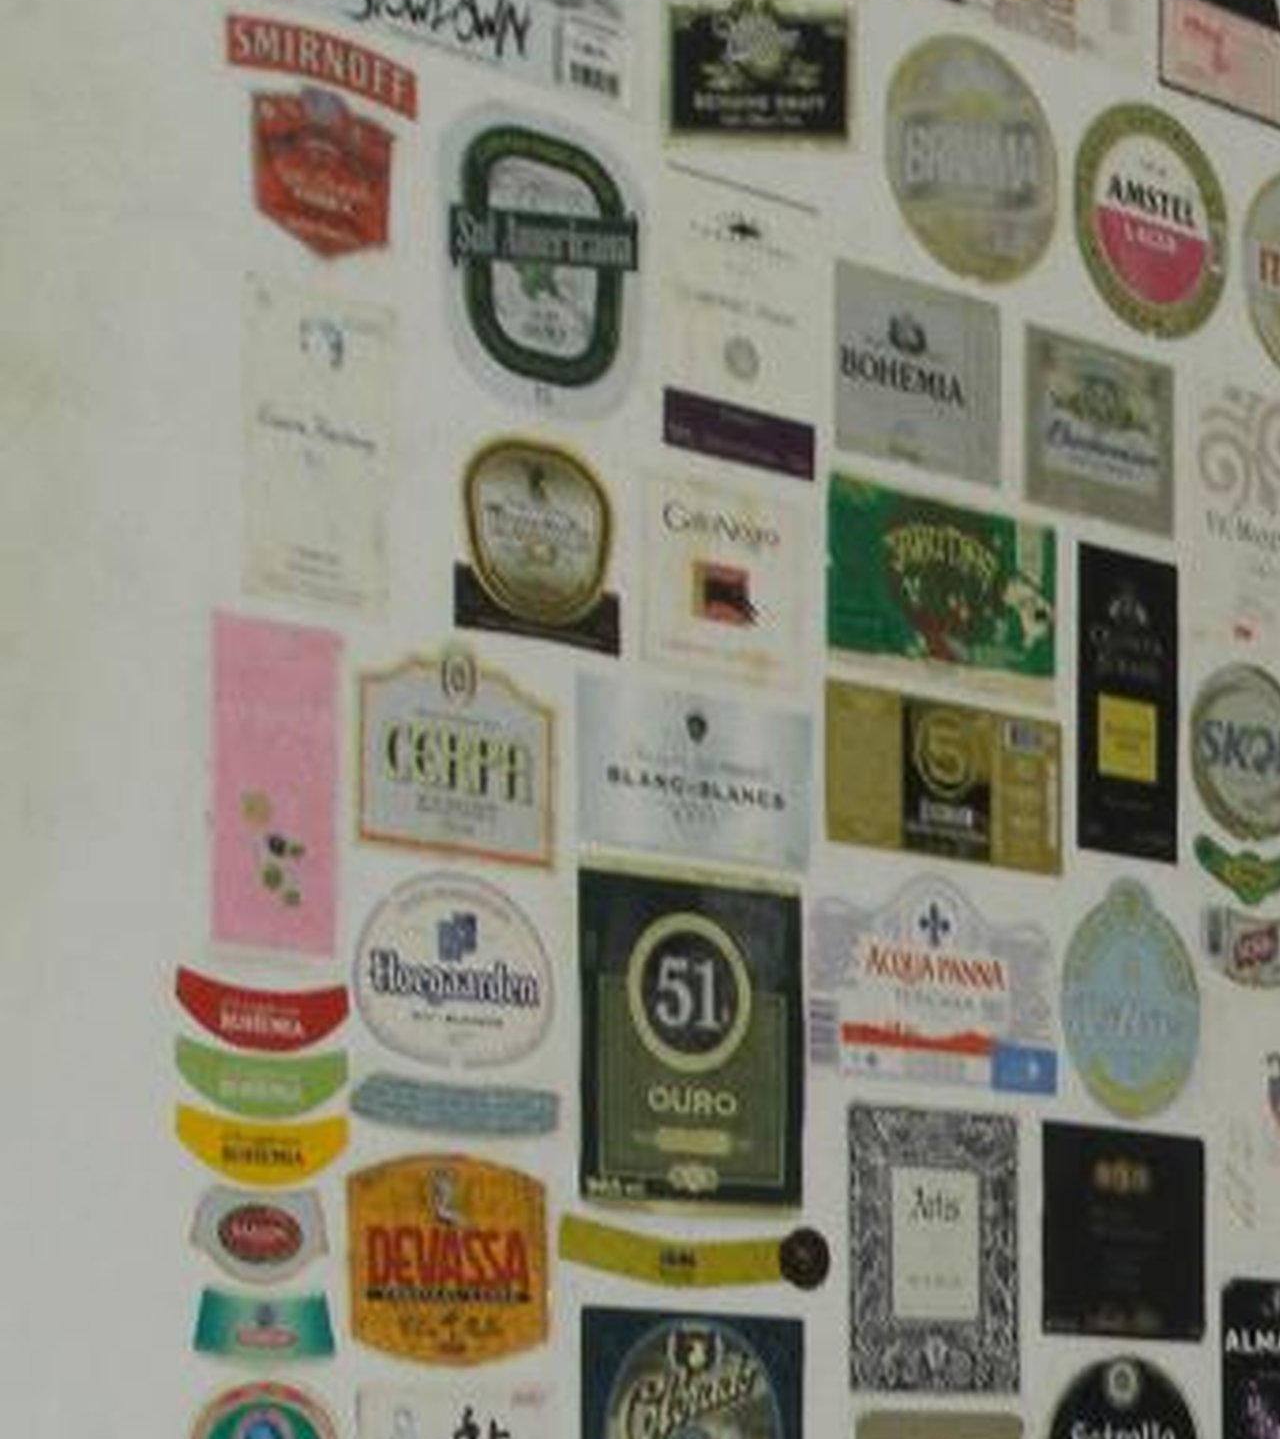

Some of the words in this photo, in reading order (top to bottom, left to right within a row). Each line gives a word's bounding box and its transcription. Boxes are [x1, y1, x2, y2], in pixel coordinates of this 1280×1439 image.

[231, 17, 411, 104] SMIRNOFF
[1107, 173, 1197, 229] AMSTEL
[841, 345, 966, 409] BOHEMIA
[368, 948, 542, 1010] Hoegaarden
[655, 955, 723, 1030] 51
[648, 1087, 738, 1119] OURO
[365, 1223, 531, 1289] DEVASSA
